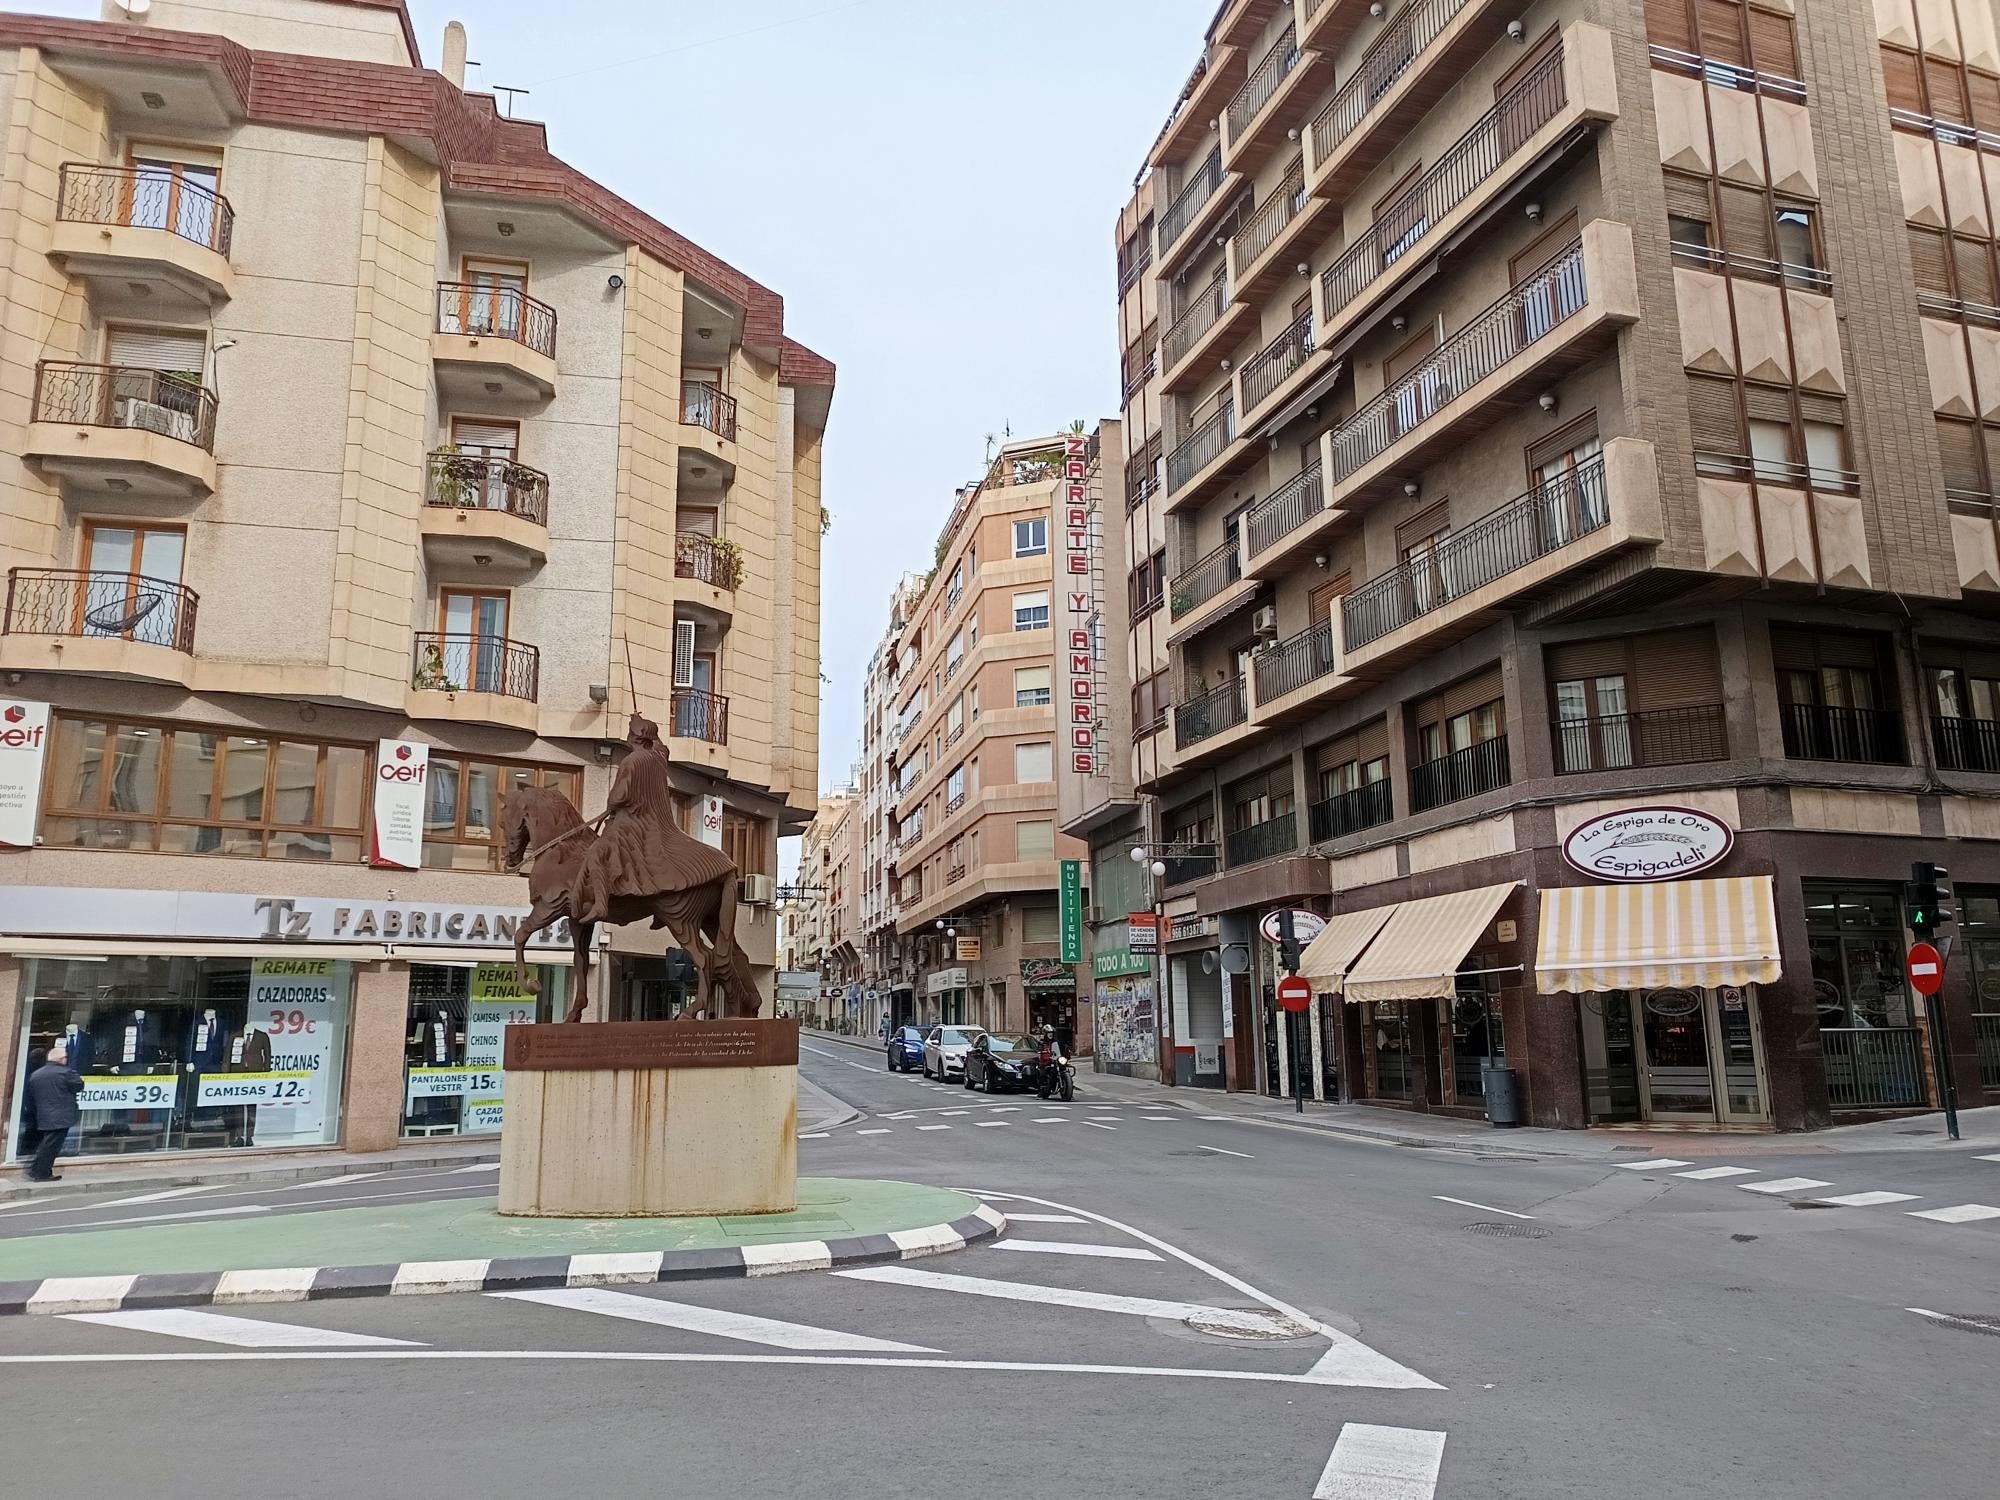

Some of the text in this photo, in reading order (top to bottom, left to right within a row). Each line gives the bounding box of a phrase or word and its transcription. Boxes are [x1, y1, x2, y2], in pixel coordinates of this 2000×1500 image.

[1067, 439, 1087, 572] ZARATE
[1071, 593, 1086, 610] Y
[1072, 631, 1092, 771] AMOROS
[0, 725, 44, 748] eif
[380, 763, 425, 783] ceif
[1580, 813, 1711, 843] La Espiga de Oro
[1066, 864, 1076, 958] MULTITIENDA
[333, 907, 571, 944] FABRICANES
[262, 961, 327, 974] REMATE
[1097, 954, 1118, 972] TODO
[1121, 953, 1127, 969] A
[257, 987, 327, 1003] CAZADORAS
[484, 986, 522, 998] FINAL
[268, 1010, 316, 1035] 39€
[472, 1012, 500, 1023] CAMISAS
[471, 1036, 498, 1046] CHINOS
[270, 1054, 320, 1071] ERICANAS
[411, 1074, 468, 1083] PANTALONES
[76, 1089, 128, 1102] ERICANAS
[205, 1085, 266, 1097] CAMISAS
[429, 1084, 462, 1092] VESTIR
[476, 1107, 503, 1116] CAZAD
[479, 1117, 486, 1125] Y
